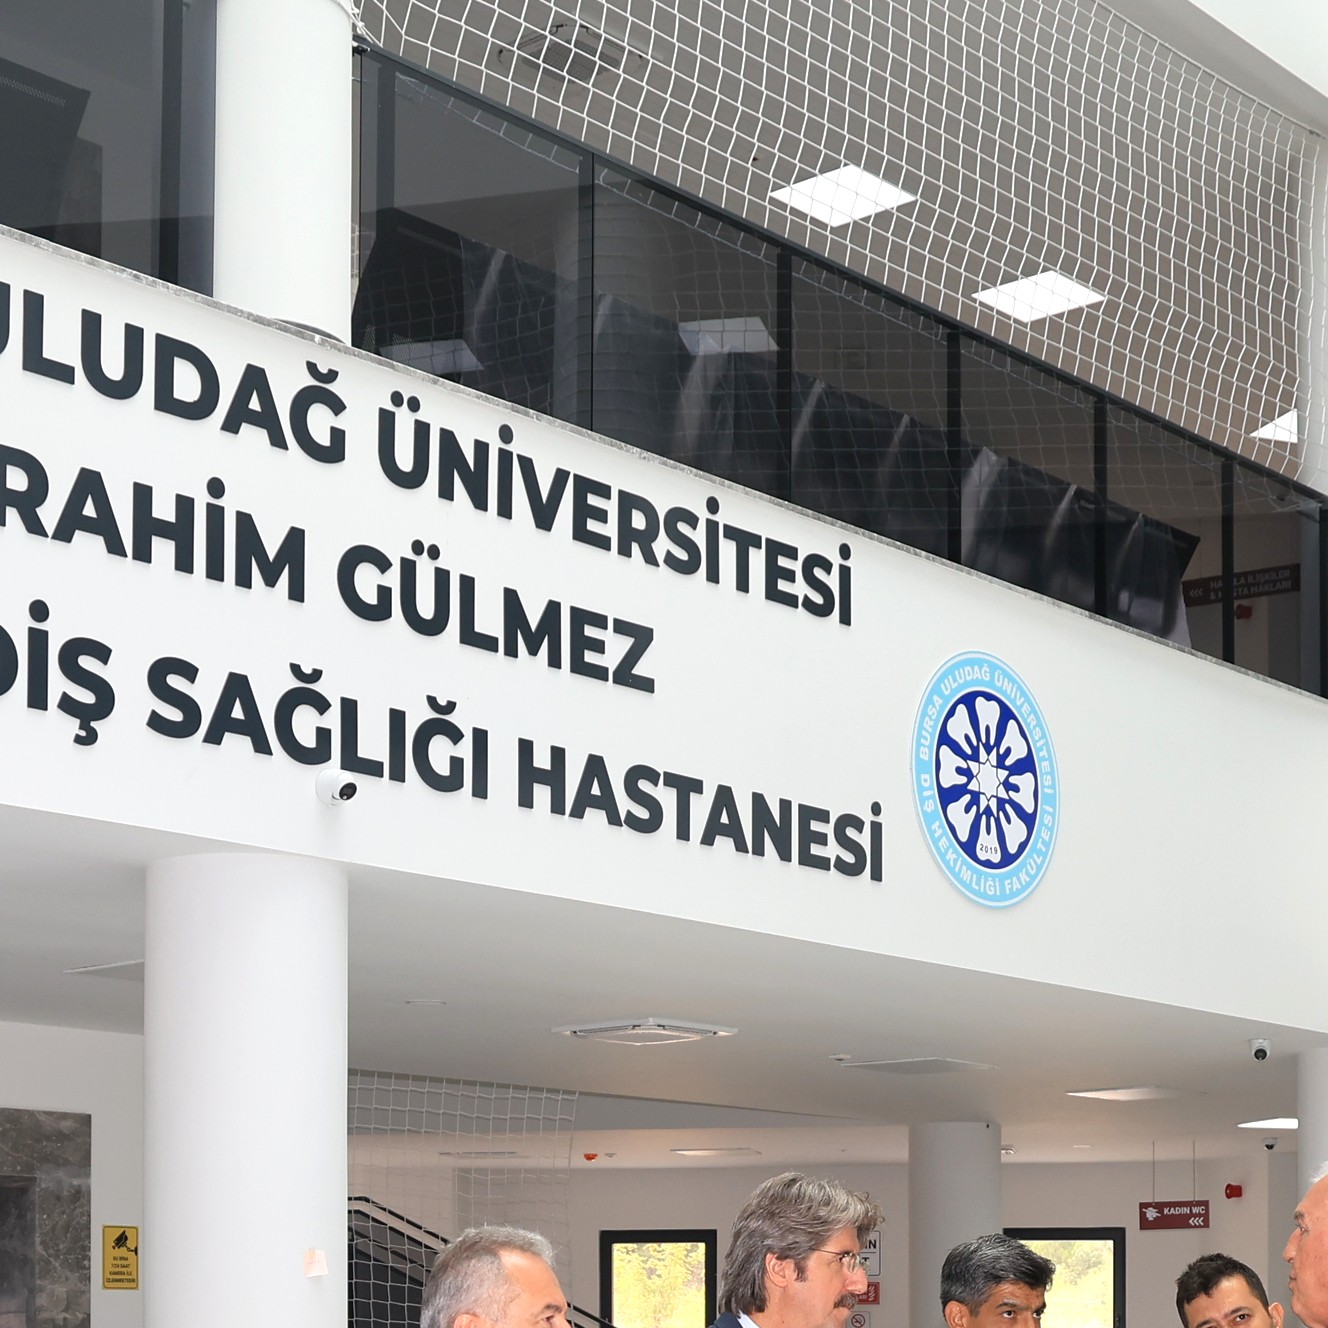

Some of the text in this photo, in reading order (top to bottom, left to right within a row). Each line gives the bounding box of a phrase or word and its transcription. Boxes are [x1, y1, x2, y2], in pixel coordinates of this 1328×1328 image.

[376, 390, 853, 627] ÜNİVERSİTESİ
[336, 539, 656, 694] GÜLMEZ
[145, 657, 489, 799] SAĞLIĞI
[516, 737, 884, 883] HASTANESİ
[919, 663, 1055, 794] BURSA ULUDAĞ ÜNİVERSİTESİ
[920, 772, 935, 813] DİŞ
[930, 820, 1001, 896] HEKİMLİĞİ
[979, 843, 998, 855] 2019
[1163, 1206, 1206, 1215] KADIN WC
